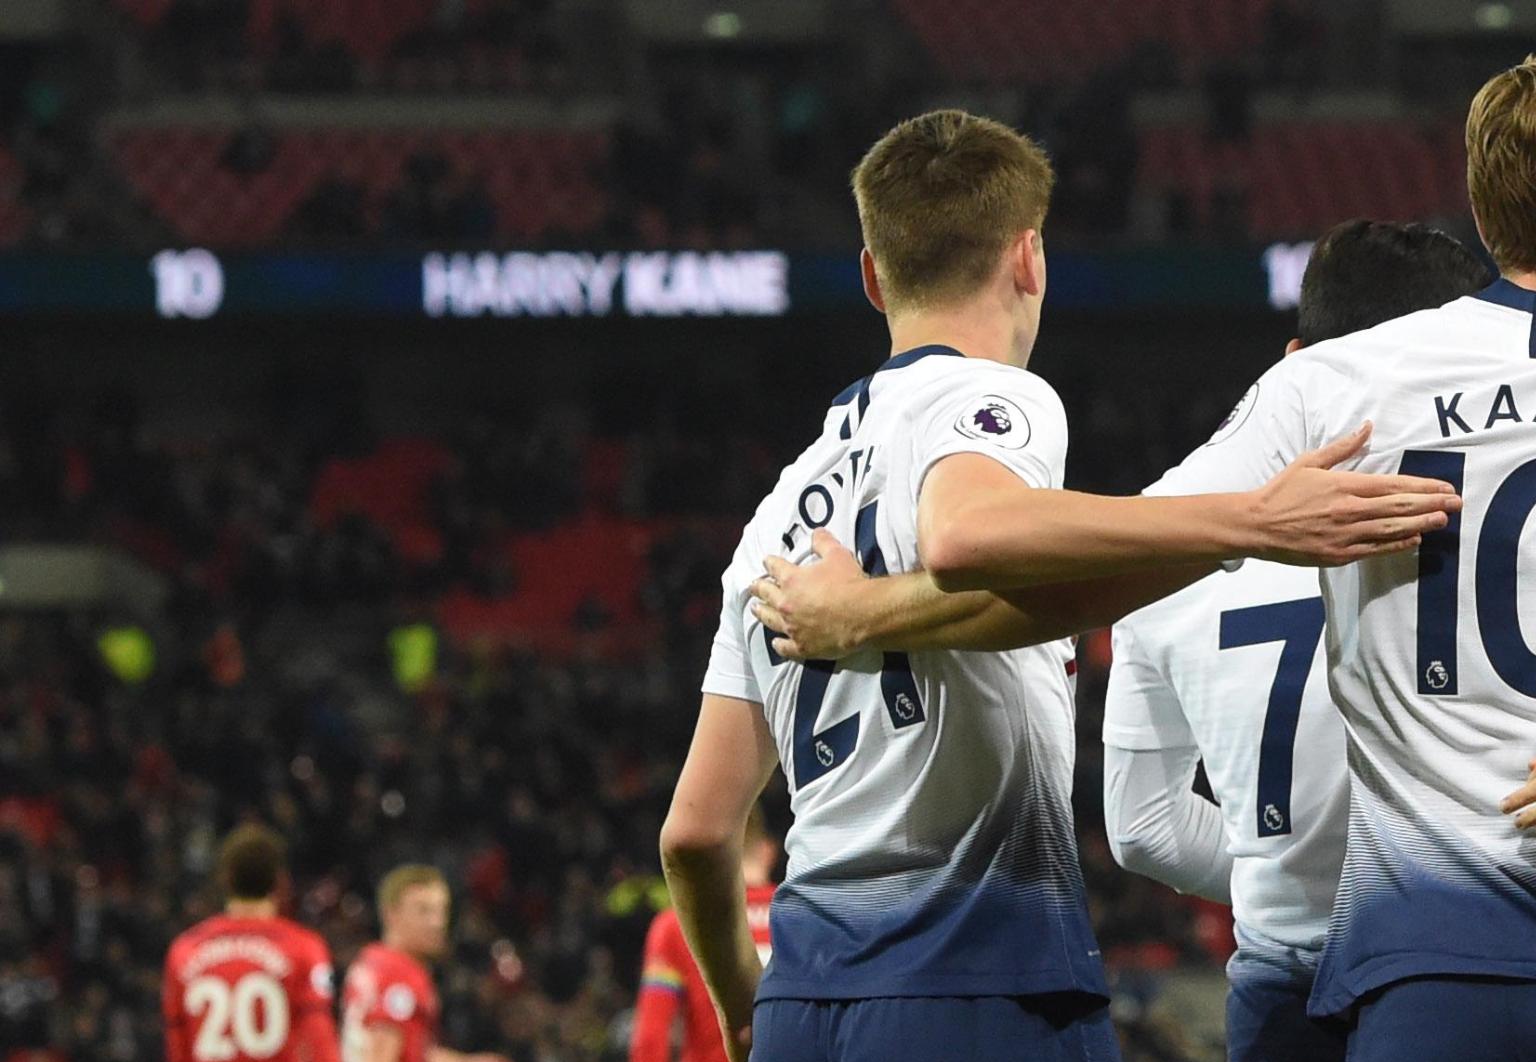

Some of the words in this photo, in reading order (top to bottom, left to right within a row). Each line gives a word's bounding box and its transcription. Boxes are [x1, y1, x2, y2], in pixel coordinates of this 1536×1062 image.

[150, 247, 224, 319] 10
[423, 250, 622, 317] HARRY
[624, 250, 788, 316] KANE
[1219, 596, 1327, 838] 7
